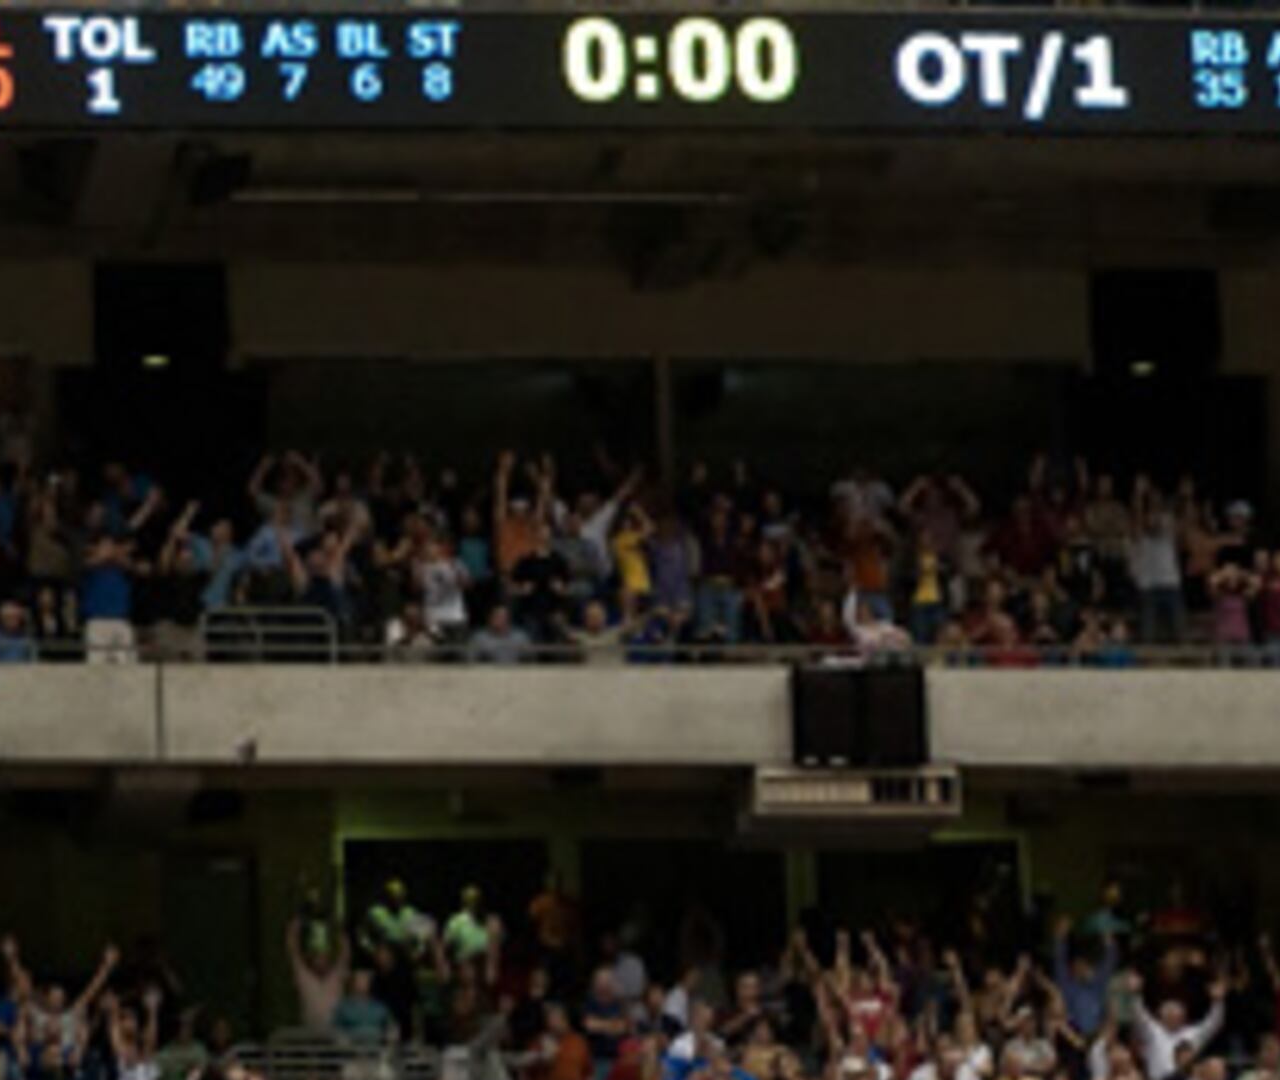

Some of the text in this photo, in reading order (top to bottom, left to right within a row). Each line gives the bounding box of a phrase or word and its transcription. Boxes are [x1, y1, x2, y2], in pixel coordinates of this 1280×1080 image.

[43, 16, 155, 61] TOL
[185, 21, 460, 58] RB AS BL ST
[564, 17, 796, 101] 0:00
[1191, 30, 1248, 66] RB
[86, 68, 120, 114] 1
[190, 62, 453, 101] 49 7 6 8
[896, 32, 1128, 119] OT/1
[1193, 69, 1248, 108] 35
